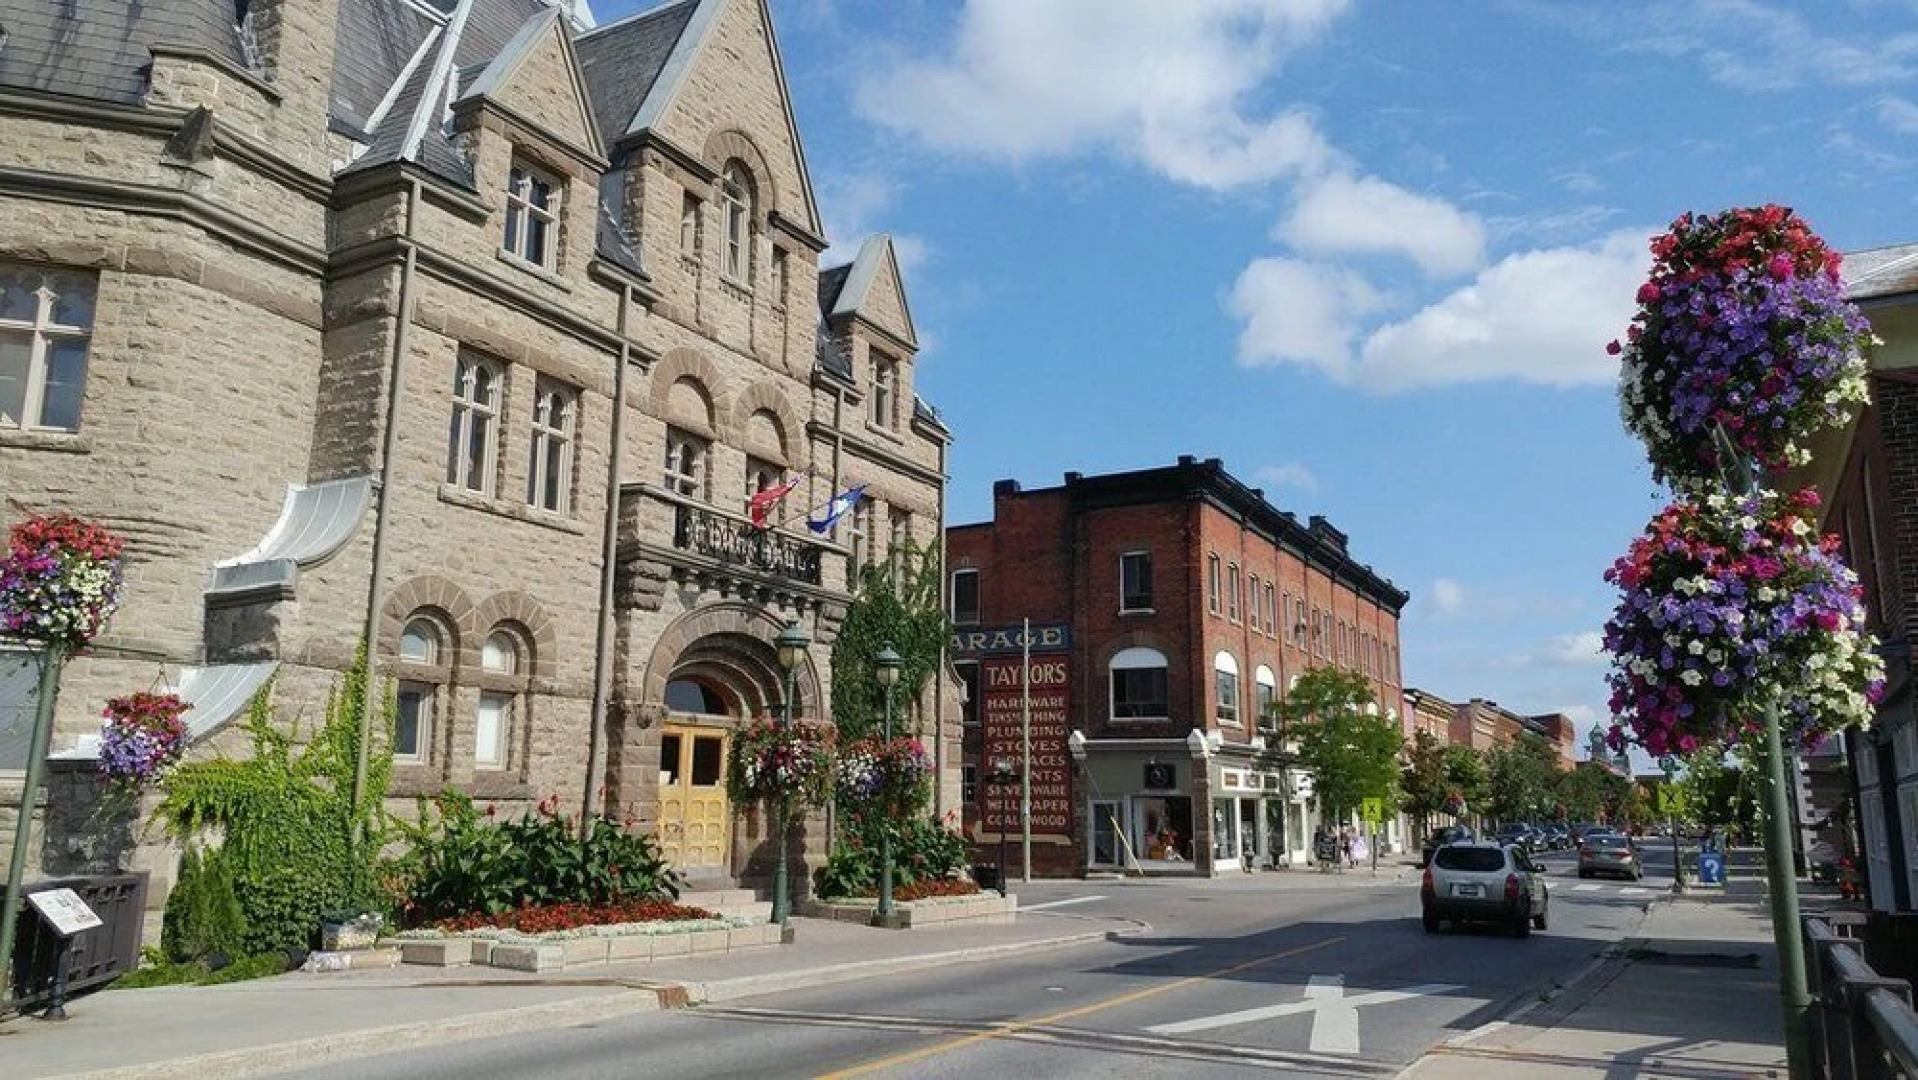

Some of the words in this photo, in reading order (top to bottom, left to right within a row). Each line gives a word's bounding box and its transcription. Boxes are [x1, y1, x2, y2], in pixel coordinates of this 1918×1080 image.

[949, 626, 1062, 650] ARAGE
[988, 709, 1066, 723] TINSMHING
[987, 784, 1067, 796] SIVEWARE
[987, 799, 1069, 812] WLLAPER
